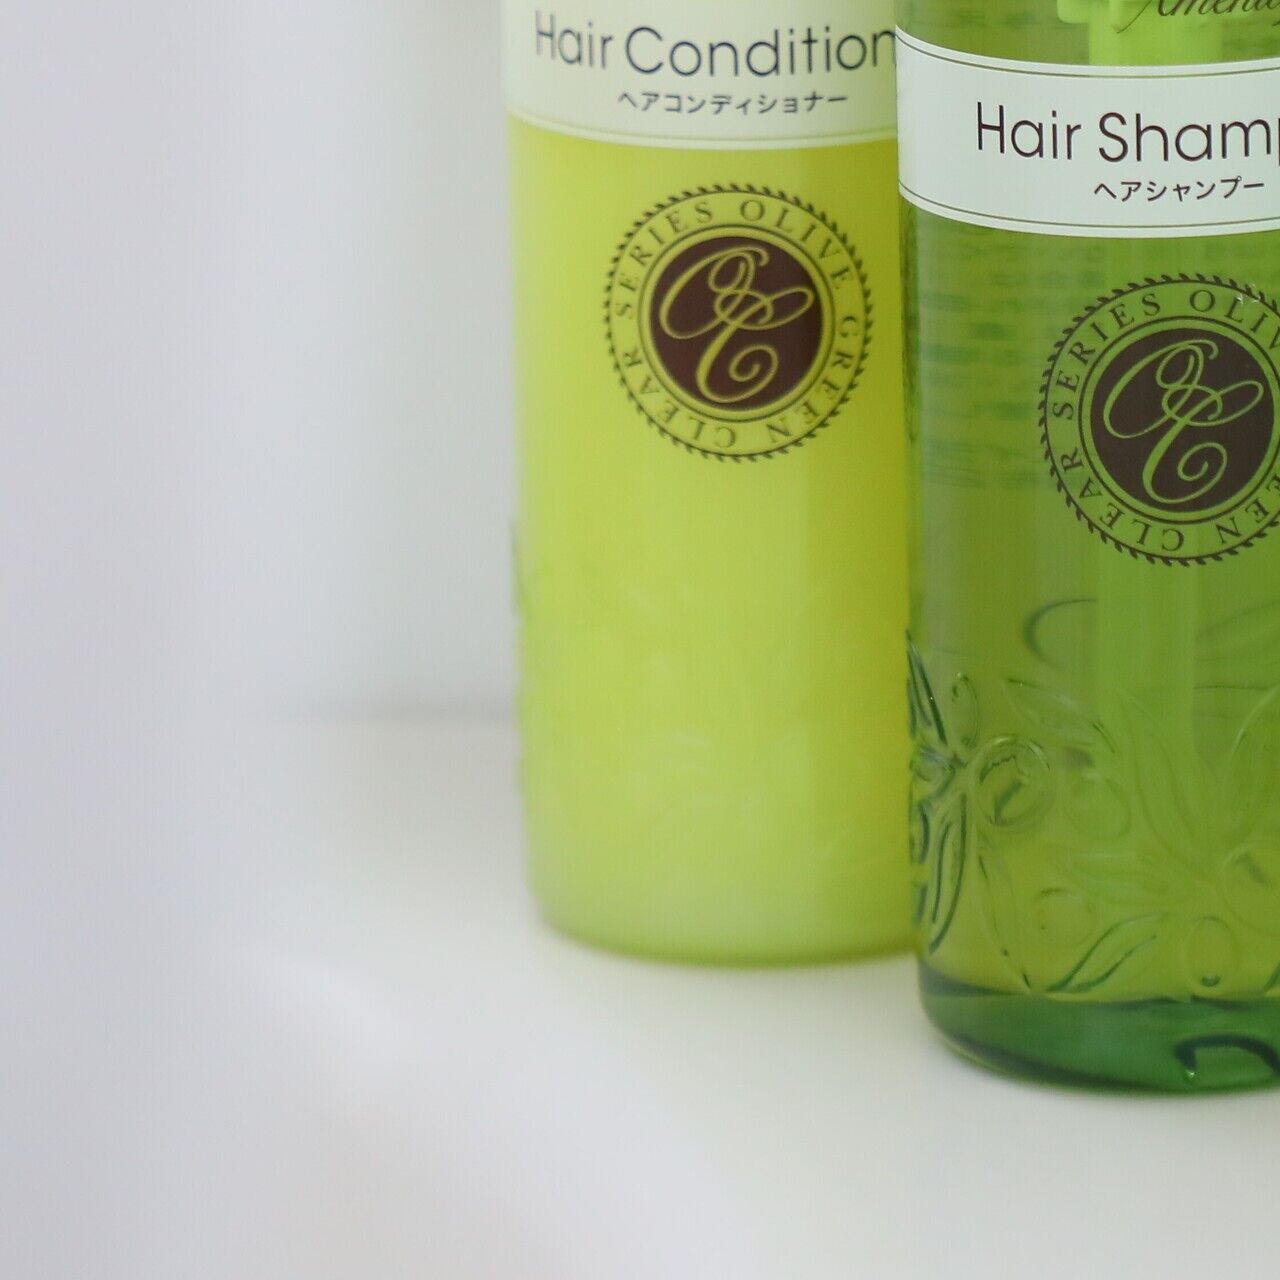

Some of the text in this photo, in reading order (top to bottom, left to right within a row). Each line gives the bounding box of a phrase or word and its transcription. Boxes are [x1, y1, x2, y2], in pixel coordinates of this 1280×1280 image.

[534, 8, 614, 69] Hair
[617, 90, 849, 115] ヘアコンディショナー
[976, 101, 1082, 161] Hair
[1093, 174, 1266, 203] ヘアシャンプー
[616, 199, 714, 320] SERIES
[740, 199, 854, 291] OLIVE
[622, 349, 737, 449] CLEAR
[766, 315, 859, 443] GREEN
[1053, 292, 1161, 420] SERIES
[1060, 446, 1185, 552] CLEAR
